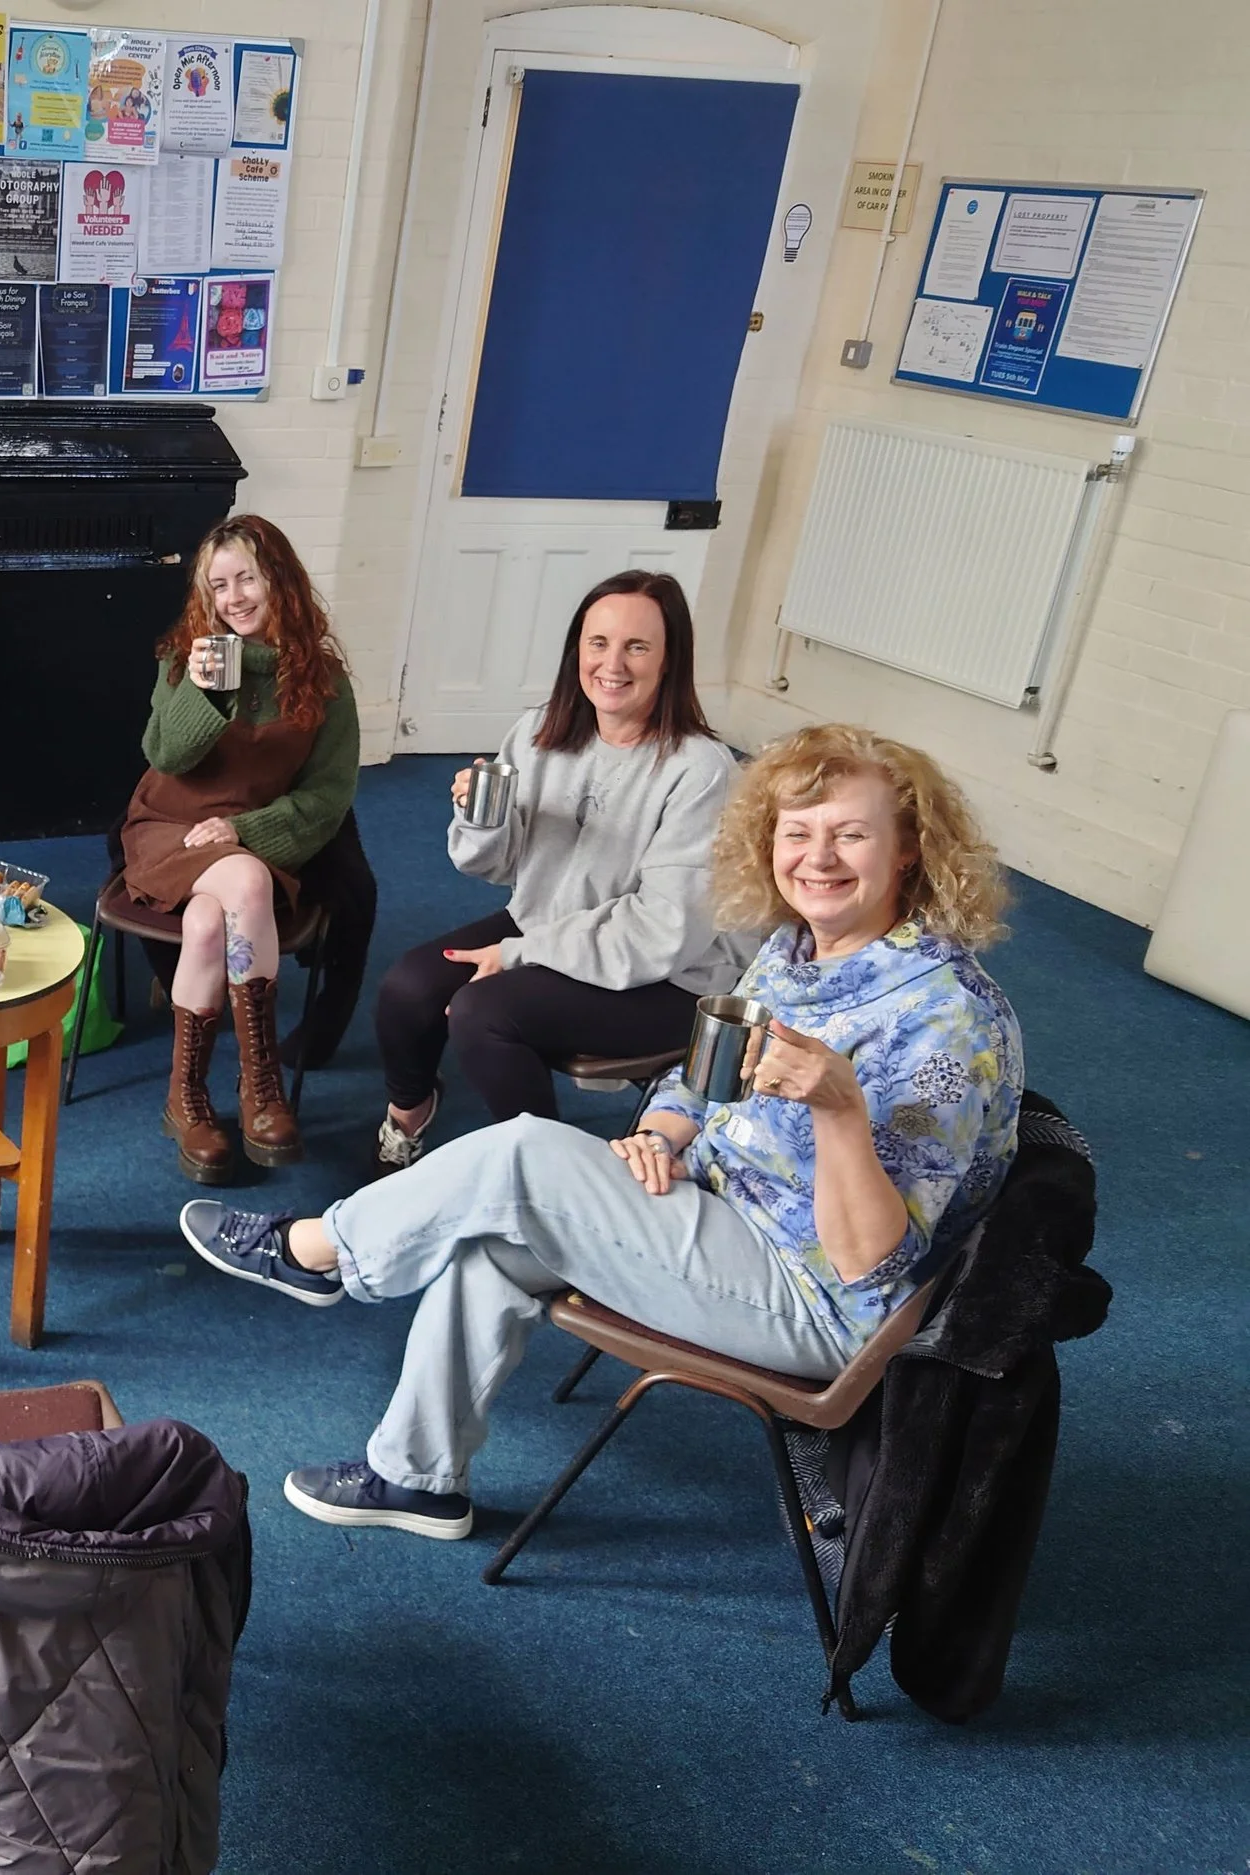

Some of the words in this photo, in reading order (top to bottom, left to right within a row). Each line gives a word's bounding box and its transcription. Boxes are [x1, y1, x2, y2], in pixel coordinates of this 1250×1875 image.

[121, 45, 159, 53] COMMUNITY
[172, 67, 183, 90] Open
[180, 55, 195, 68] Mic
[196, 53, 221, 91] Afternoon
[242, 156, 270, 166] Chatty
[239, 173, 270, 182] Scheme
[868, 171, 894, 181] SMOKIN
[854, 186, 871, 195] AREA
[871, 187, 879, 196] IN
[880, 188, 907, 198] COER
[6, 193, 39, 205] GROUP
[857, 201, 866, 209] OF
[866, 201, 879, 210] CAR
[83, 215, 124, 224] Volunteers
[1032, 212, 1068, 220] PROPERTY
[83, 225, 124, 236] NEEDED
[9, 286, 19, 295] for
[63, 291, 72, 299] Le
[72, 291, 87, 299] Soir
[4, 295, 27, 305] Dining
[60, 299, 89, 309] Français
[991, 370, 1006, 378] TUES
[1017, 373, 1031, 385] May
